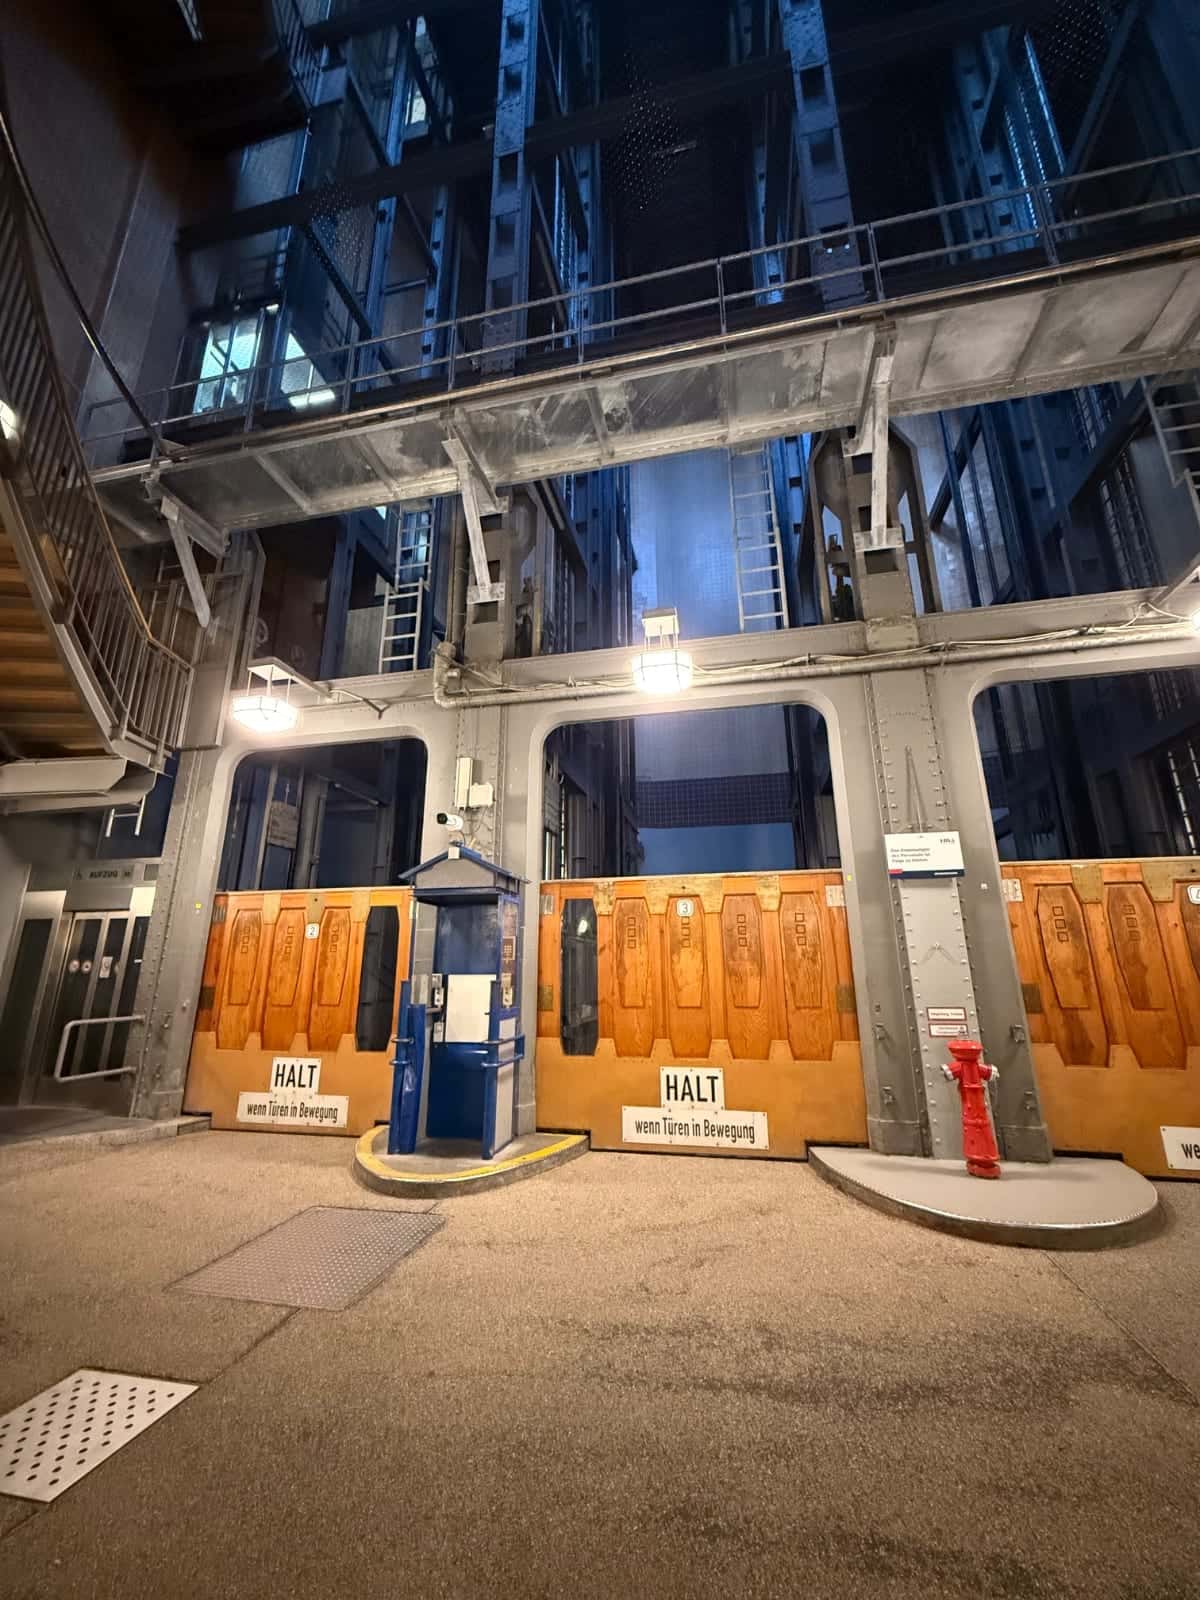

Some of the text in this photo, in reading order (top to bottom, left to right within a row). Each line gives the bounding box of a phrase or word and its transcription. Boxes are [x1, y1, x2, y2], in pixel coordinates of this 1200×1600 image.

[682, 903, 689, 913] 3
[309, 926, 316, 936] 2
[274, 1064, 317, 1088] HALT
[666, 1074, 719, 1103] HALT
[247, 1100, 338, 1123] wenn Türen in Bewegung
[635, 1117, 755, 1144] wenn Türen in Bewegung
